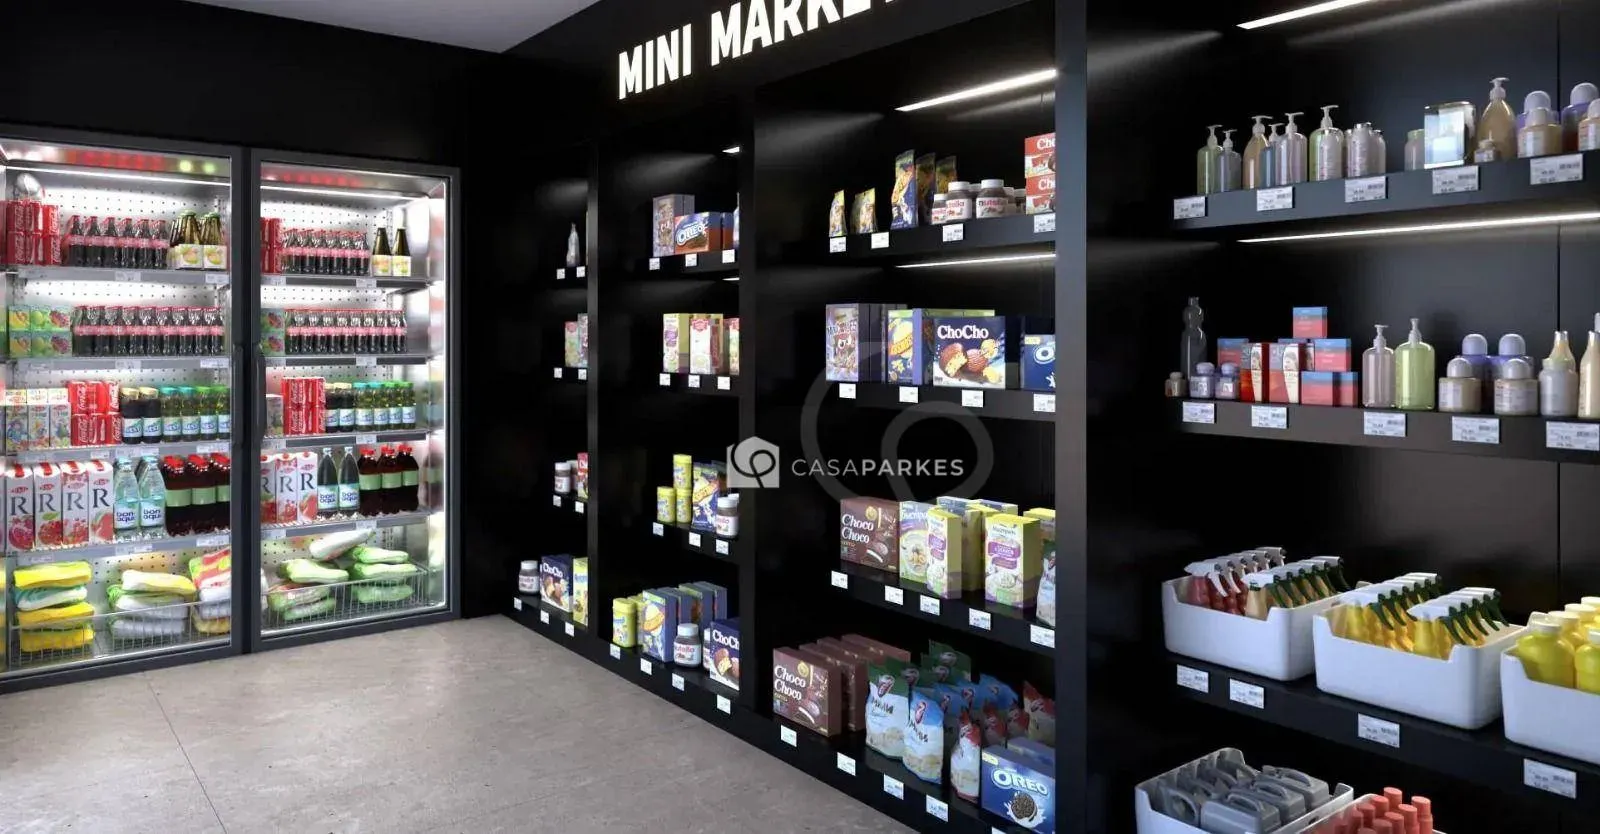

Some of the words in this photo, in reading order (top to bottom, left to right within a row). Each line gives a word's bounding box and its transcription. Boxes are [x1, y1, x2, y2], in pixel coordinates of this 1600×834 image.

[619, 23, 691, 100] MINI
[711, 0, 893, 66] MARK
[677, 223, 705, 245] OREO
[937, 325, 989, 339] ChoCho
[280, 476, 294, 493] R
[301, 473, 314, 491] R
[11, 496, 28, 516] R
[39, 493, 56, 513] R
[67, 491, 84, 511] R
[93, 488, 110, 508] R
[842, 513, 874, 531] Choco
[842, 526, 870, 544] Choco
[774, 665, 806, 688] Choco
[774, 678, 802, 701] Choco
[992, 768, 1049, 796] OREO
